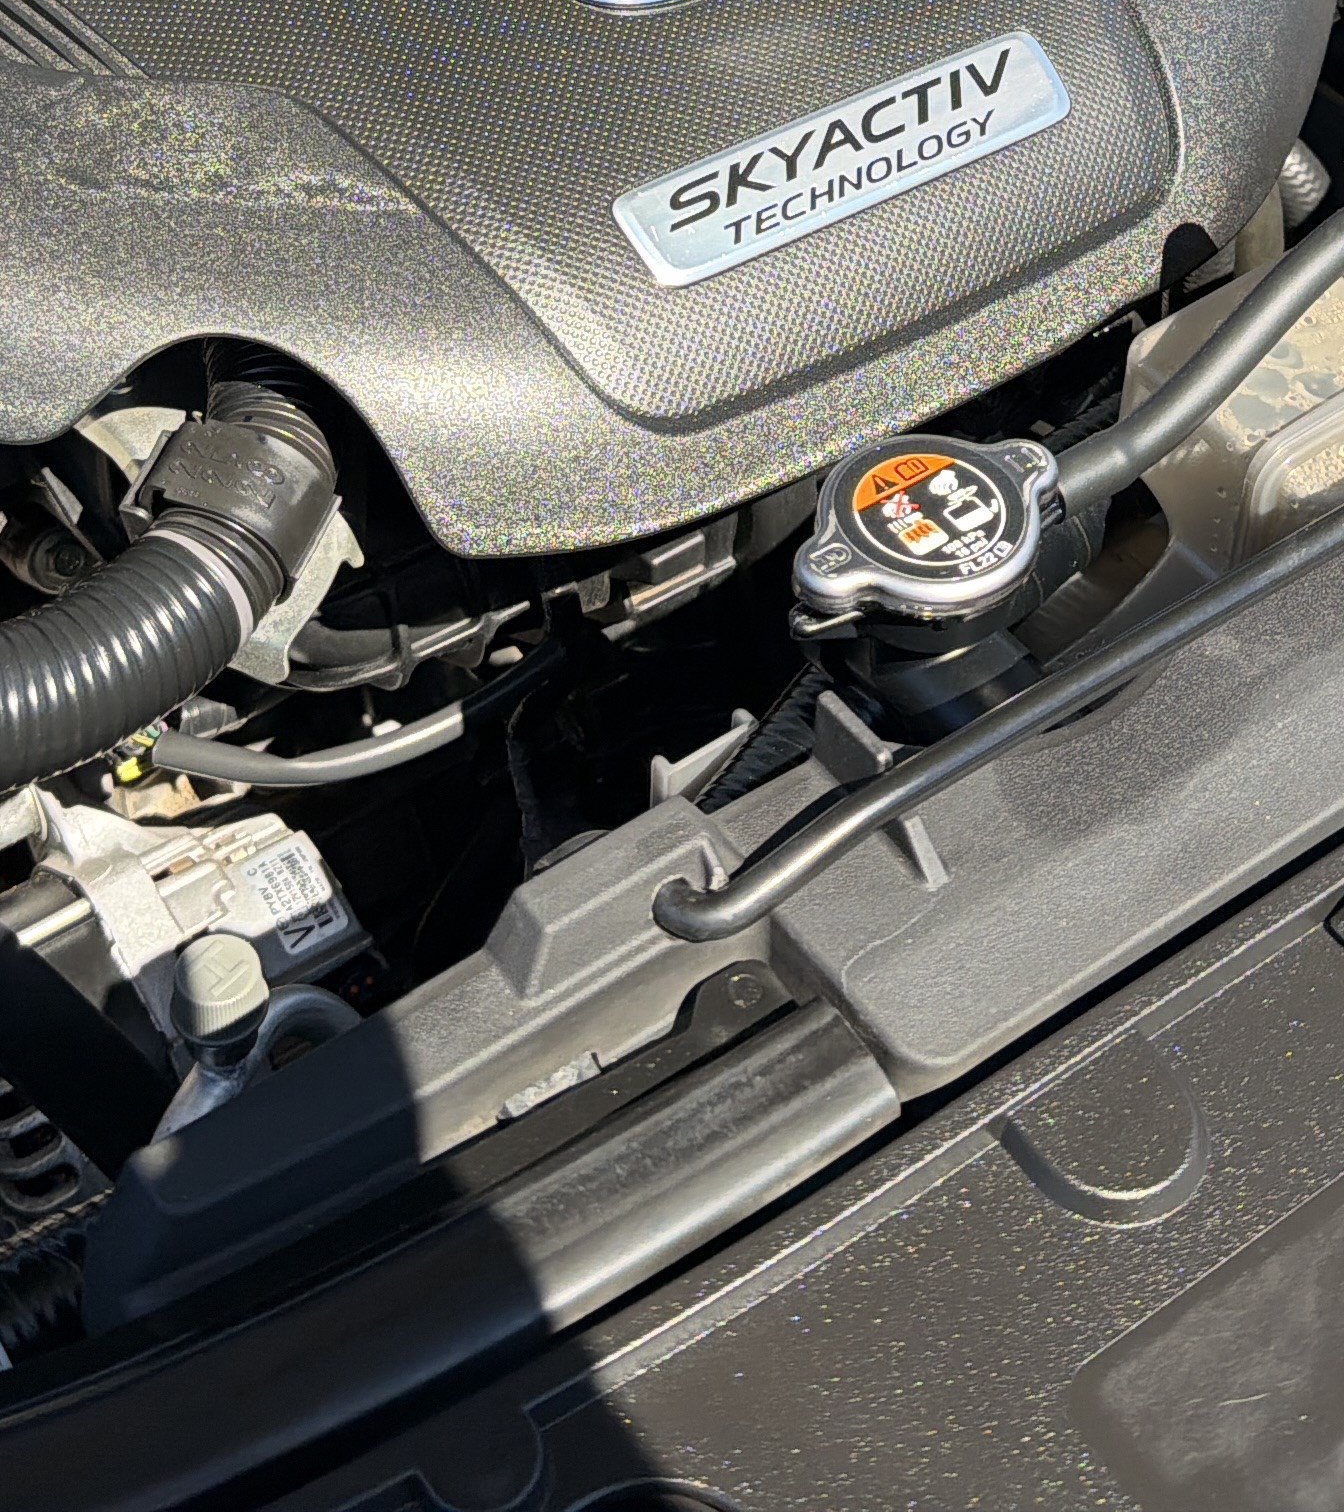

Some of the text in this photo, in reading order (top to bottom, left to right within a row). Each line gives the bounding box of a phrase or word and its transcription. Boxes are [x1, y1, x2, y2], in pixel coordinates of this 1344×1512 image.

[669, 48, 1011, 233] SKYACTIV
[723, 109, 995, 245] TECHNOLOGY
[958, 551, 998, 574] FL22
